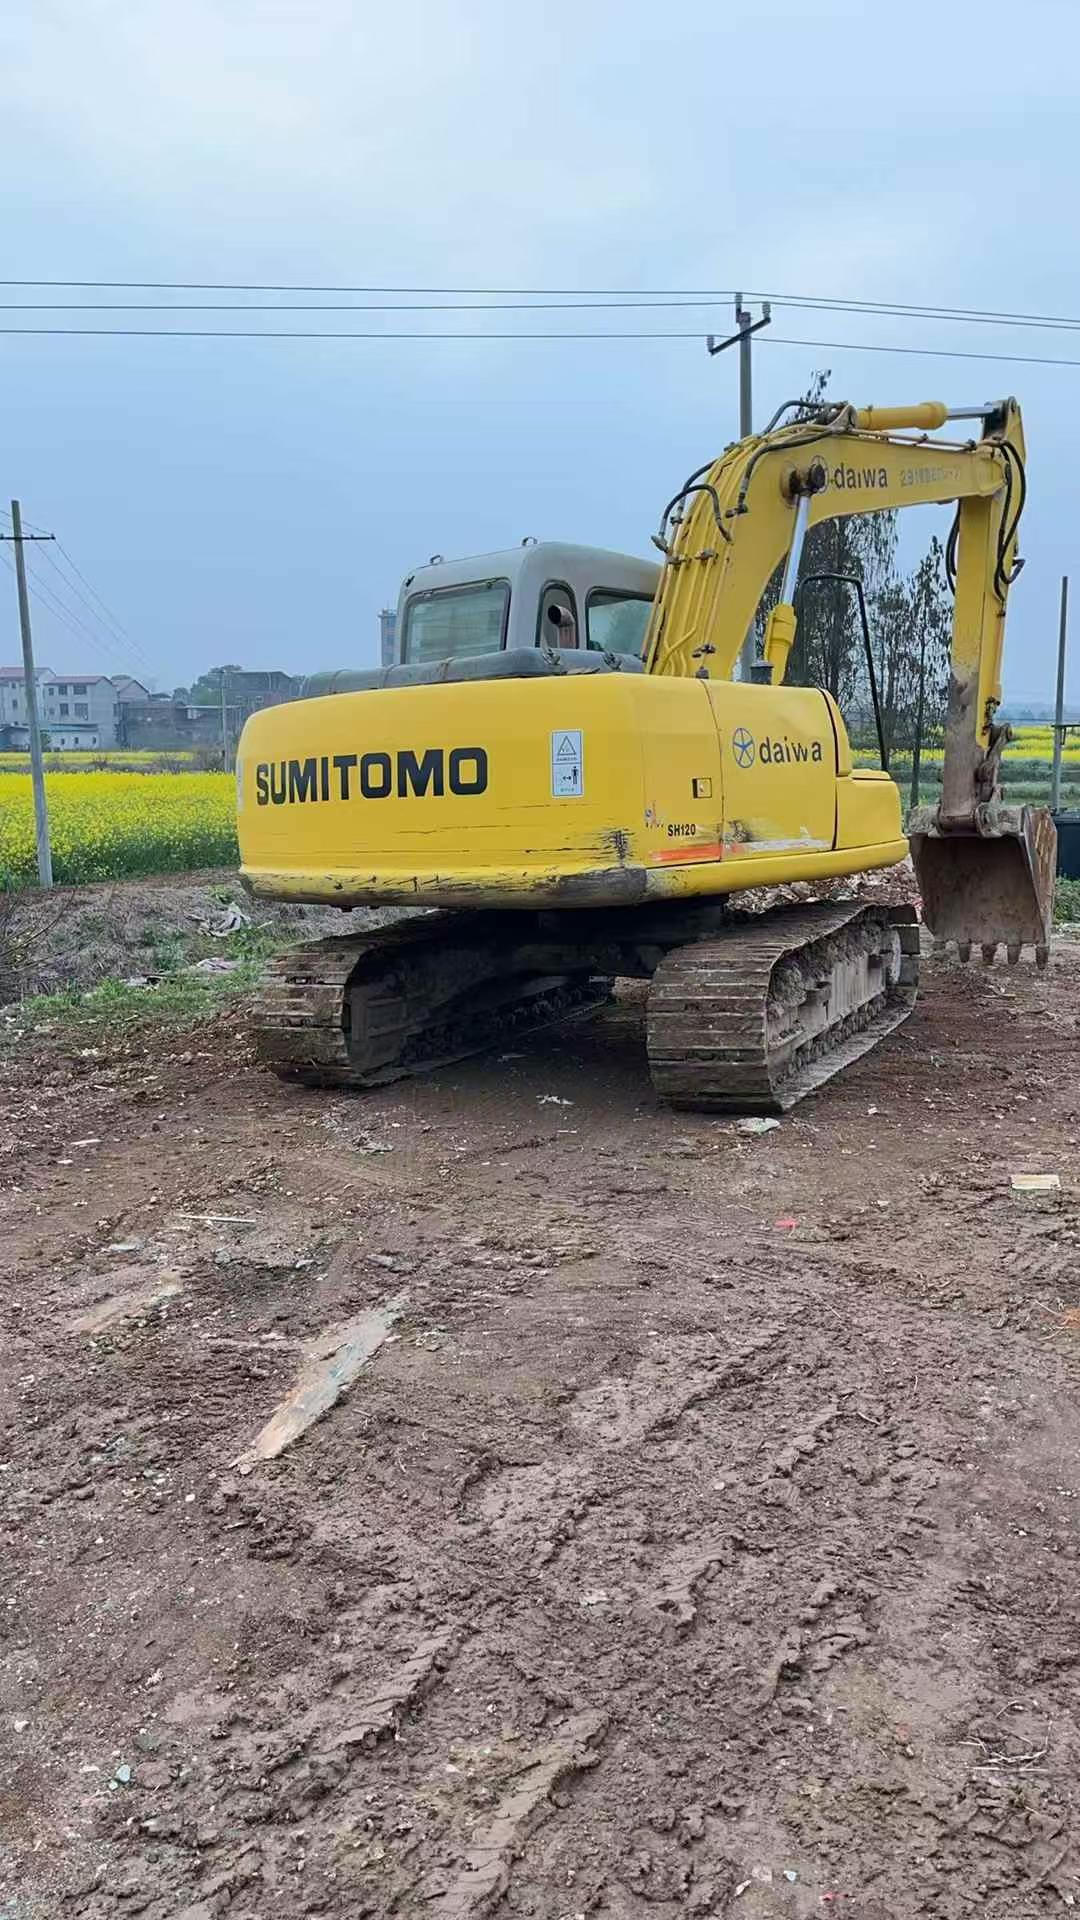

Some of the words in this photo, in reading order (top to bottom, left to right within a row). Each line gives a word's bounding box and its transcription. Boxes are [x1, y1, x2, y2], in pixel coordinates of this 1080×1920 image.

[834, 462, 888, 489] daiwa
[759, 736, 822, 764] daiwa
[256, 747, 488, 806] SUMITOMO
[667, 823, 697, 837] SH120
